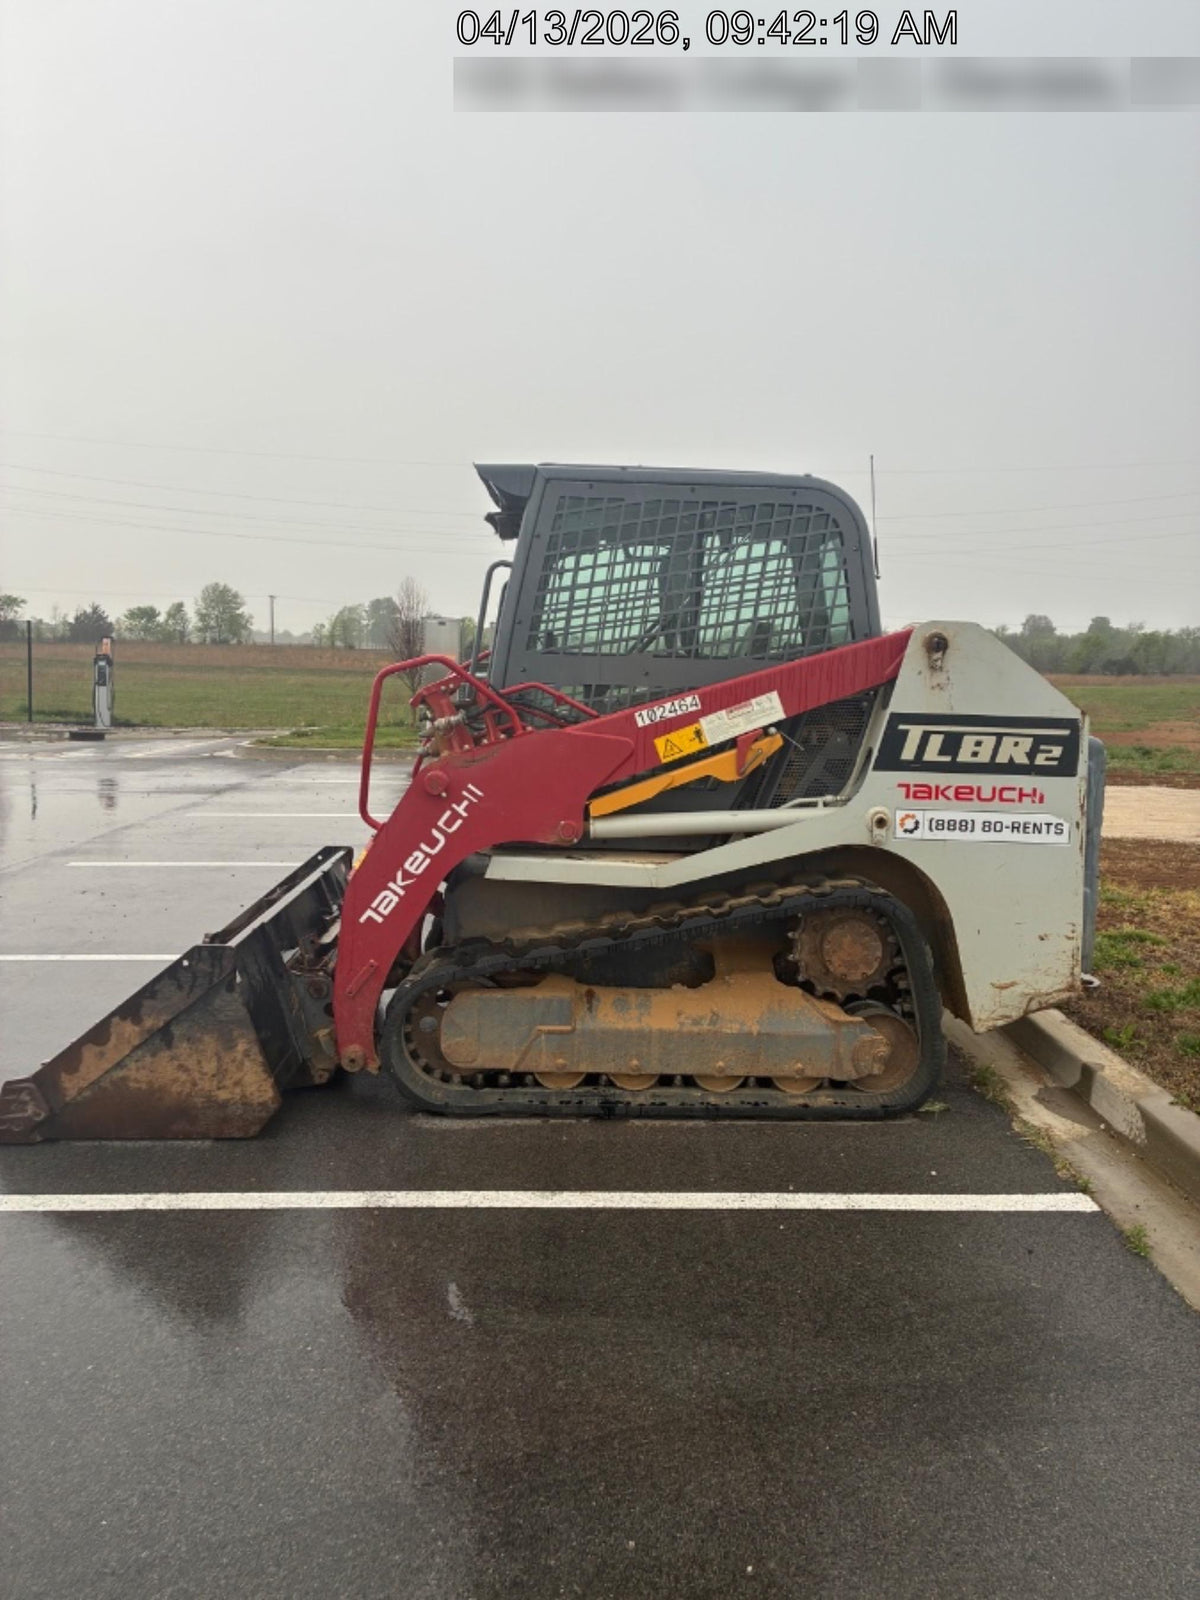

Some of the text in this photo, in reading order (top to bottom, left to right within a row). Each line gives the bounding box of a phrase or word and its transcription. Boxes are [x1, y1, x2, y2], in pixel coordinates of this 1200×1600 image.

[637, 695, 700, 725] 102464
[898, 725, 1071, 766] TL8R2
[928, 819, 1065, 836] (888) 80-RENTS
